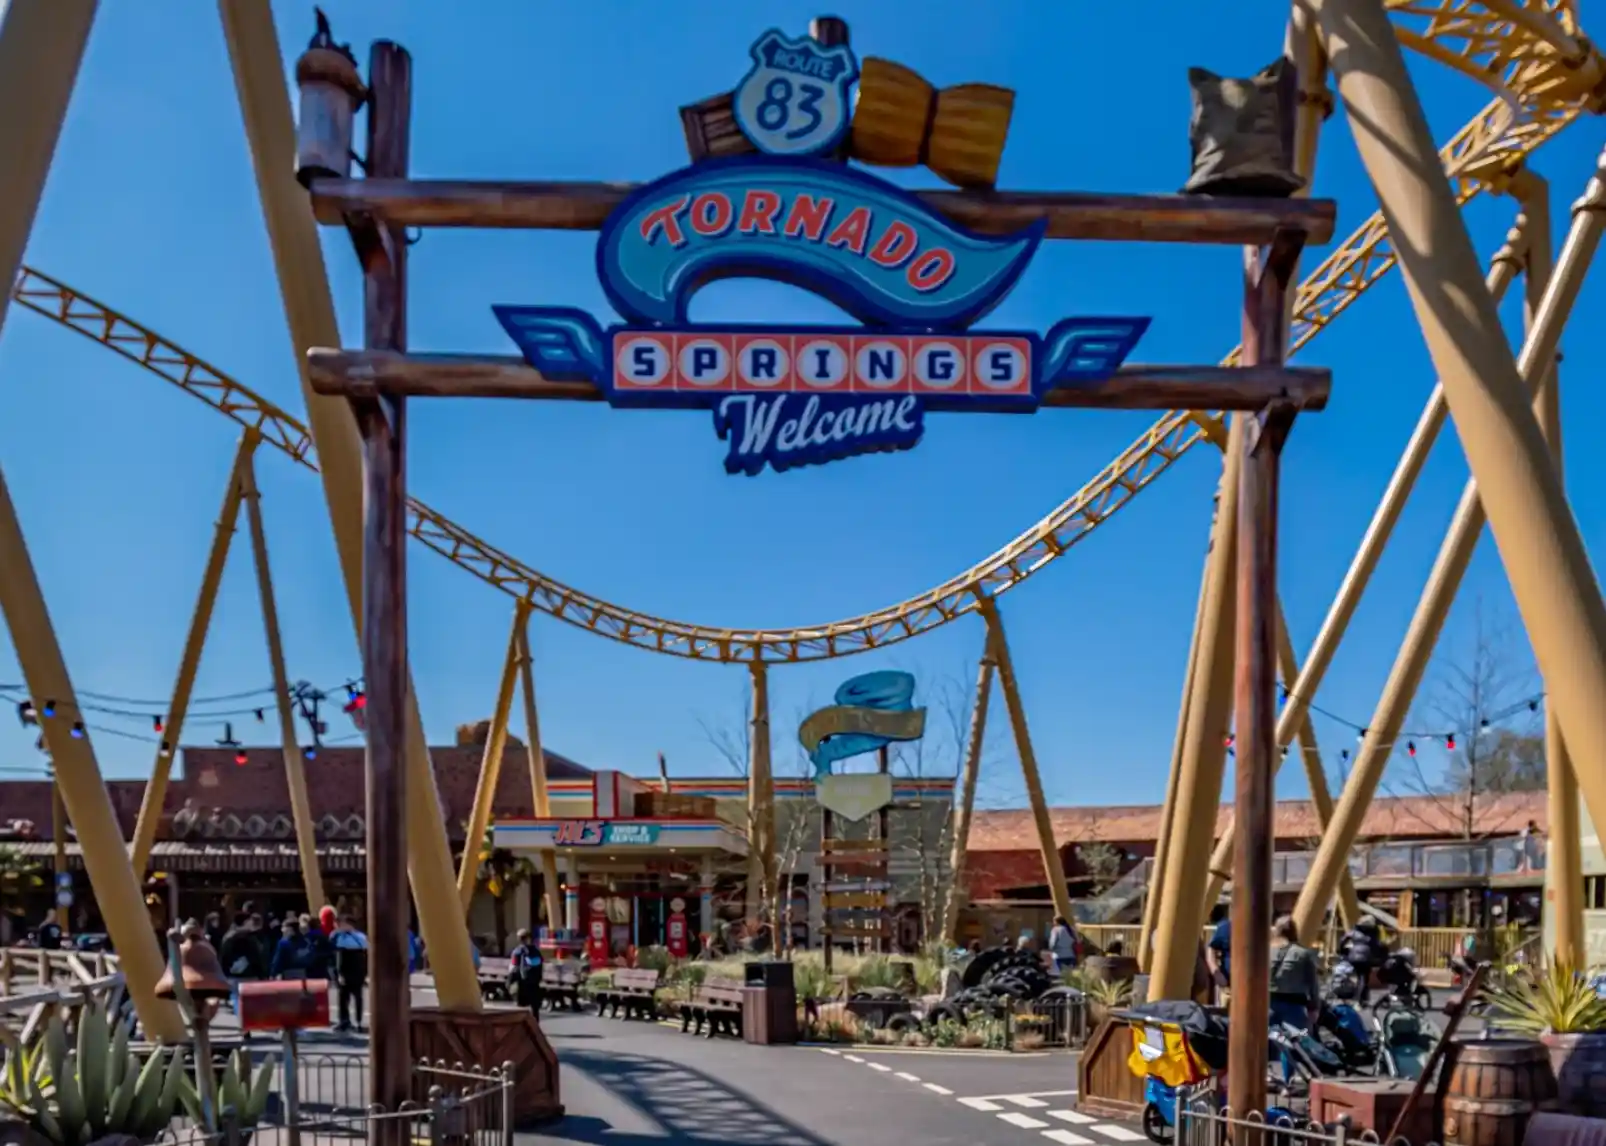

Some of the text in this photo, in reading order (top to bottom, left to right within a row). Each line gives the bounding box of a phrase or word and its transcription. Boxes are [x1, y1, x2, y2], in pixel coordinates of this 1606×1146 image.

[773, 48, 833, 78] ROUTE
[756, 76, 825, 139] 83
[639, 189, 955, 291] TORNADO
[632, 345, 1013, 382] SPRINGS
[719, 394, 917, 455] Welcome
